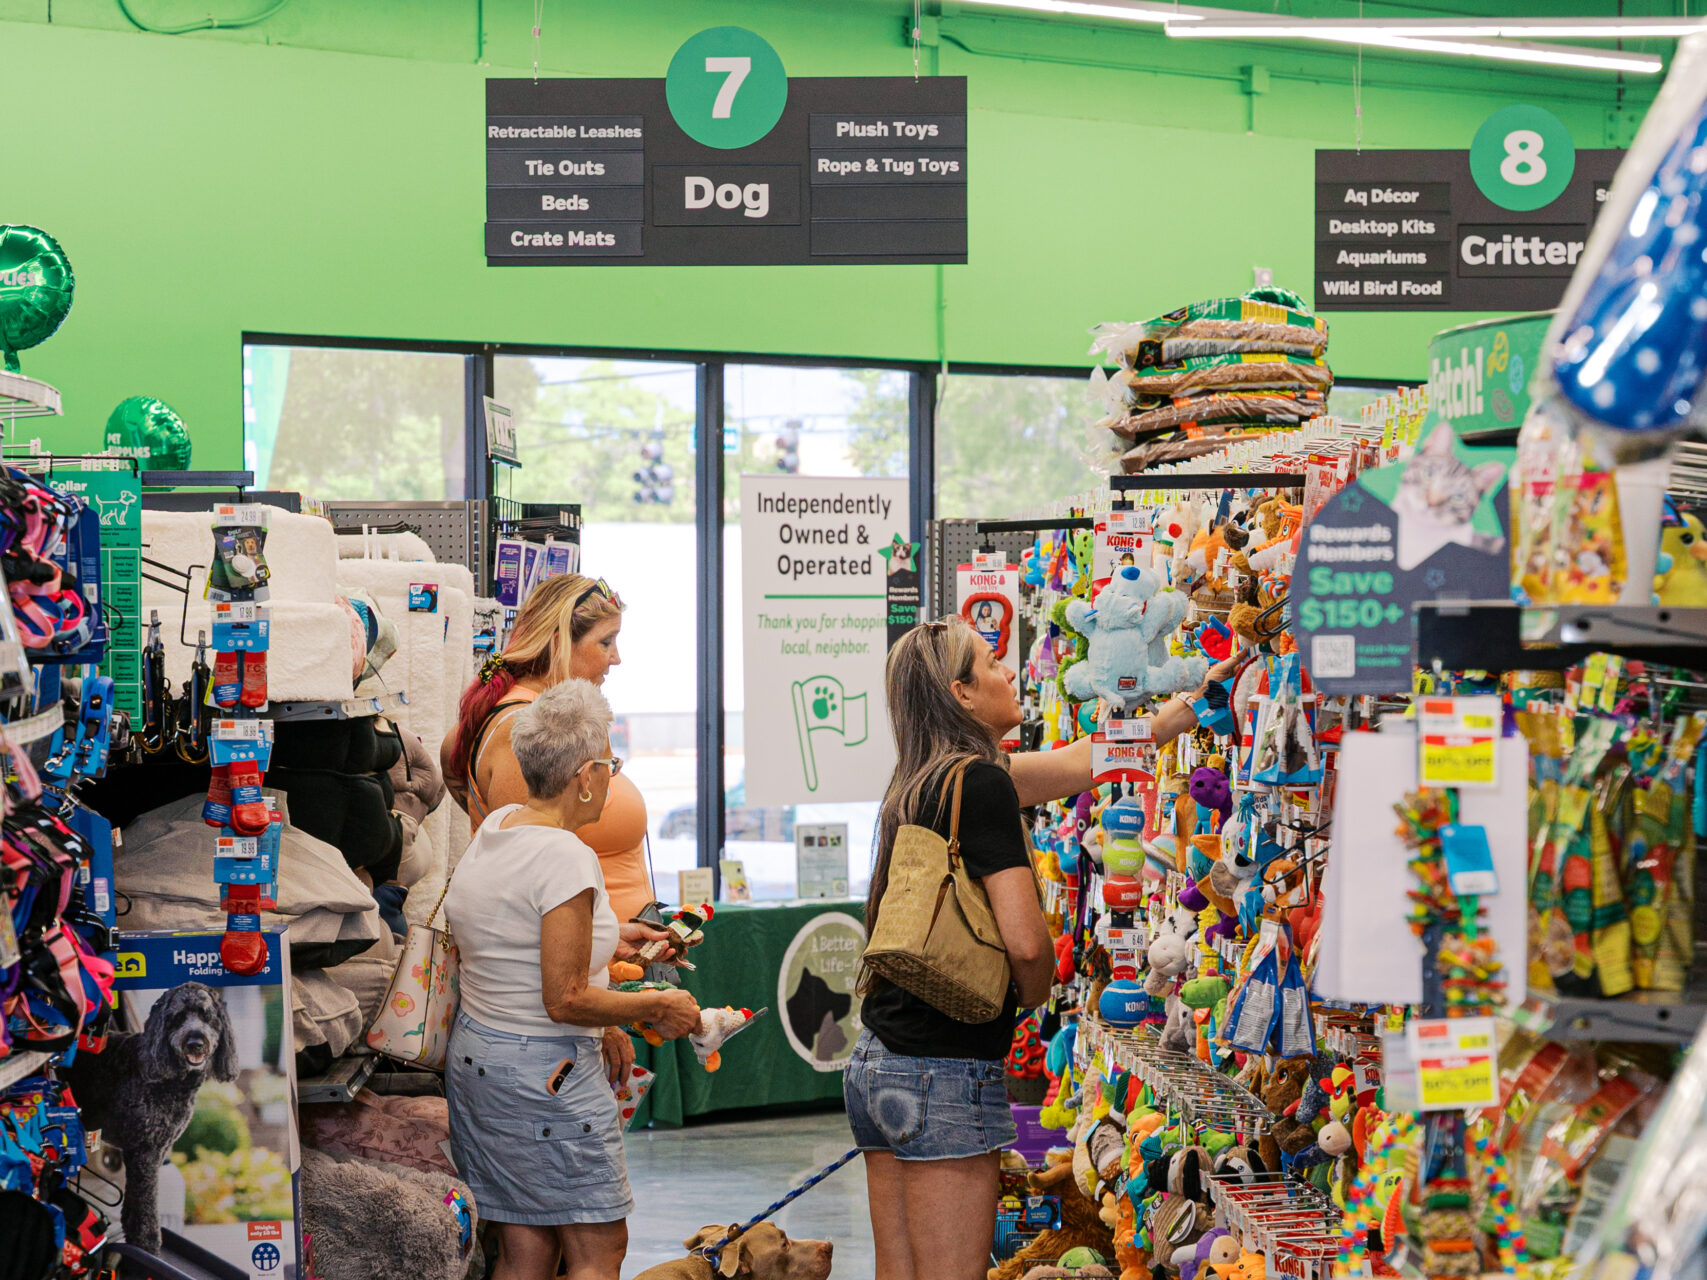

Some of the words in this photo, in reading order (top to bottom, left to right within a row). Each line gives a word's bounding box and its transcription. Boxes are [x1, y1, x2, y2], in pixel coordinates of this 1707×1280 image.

[705, 56, 752, 119] 7
[488, 125, 576, 139] Retractable
[579, 125, 642, 139] Leashes
[836, 121, 889, 137] Plush
[892, 121, 939, 142] Toys
[818, 158, 863, 176] Rope
[865, 158, 879, 173] &
[881, 158, 910, 175] Tug
[912, 158, 959, 176] Toys
[1500, 130, 1547, 186] 8
[525, 160, 555, 176] Tie
[558, 160, 605, 176] Outs
[542, 195, 589, 211] Beds
[684, 176, 770, 218] Dog
[1344, 189, 1368, 206] Aq
[1371, 187, 1420, 203] Décor
[1329, 220, 1398, 238] Desktop
[1401, 220, 1435, 235] Kits
[510, 231, 564, 247] Crate
[567, 231, 615, 247] Mats
[1337, 250, 1427, 268] Aquariums
[1461, 235, 1584, 266] Critter
[1323, 281, 1360, 295] Wild
[1363, 281, 1398, 295] Bird
[1401, 281, 1442, 295] Food
[49, 481, 88, 492] Collar
[757, 492, 892, 520] Independently
[779, 523, 849, 545] Owned
[856, 528, 870, 545] &
[1106, 535, 1135, 548] KONG
[1310, 523, 1392, 543] Rewards
[1307, 544, 1394, 562] Members
[777, 555, 873, 579] Operated
[970, 574, 997, 586] KONG
[1308, 566, 1394, 595] Save
[890, 603, 917, 613] Save
[1300, 597, 1404, 631] $150+
[757, 614, 791, 629] Thank
[793, 617, 817, 632] you
[817, 614, 838, 632] for
[840, 616, 887, 632] shoppin
[887, 614, 919, 625] $150+
[781, 640, 812, 656] local,
[816, 641, 870, 658] neighbor.
[1107, 746, 1136, 758] KONG
[1119, 814, 1137, 824] KONG
[188, 967, 223, 977] Folding
[1124, 1001, 1145, 1013] KONG
[1274, 1253, 1299, 1277] KONG
